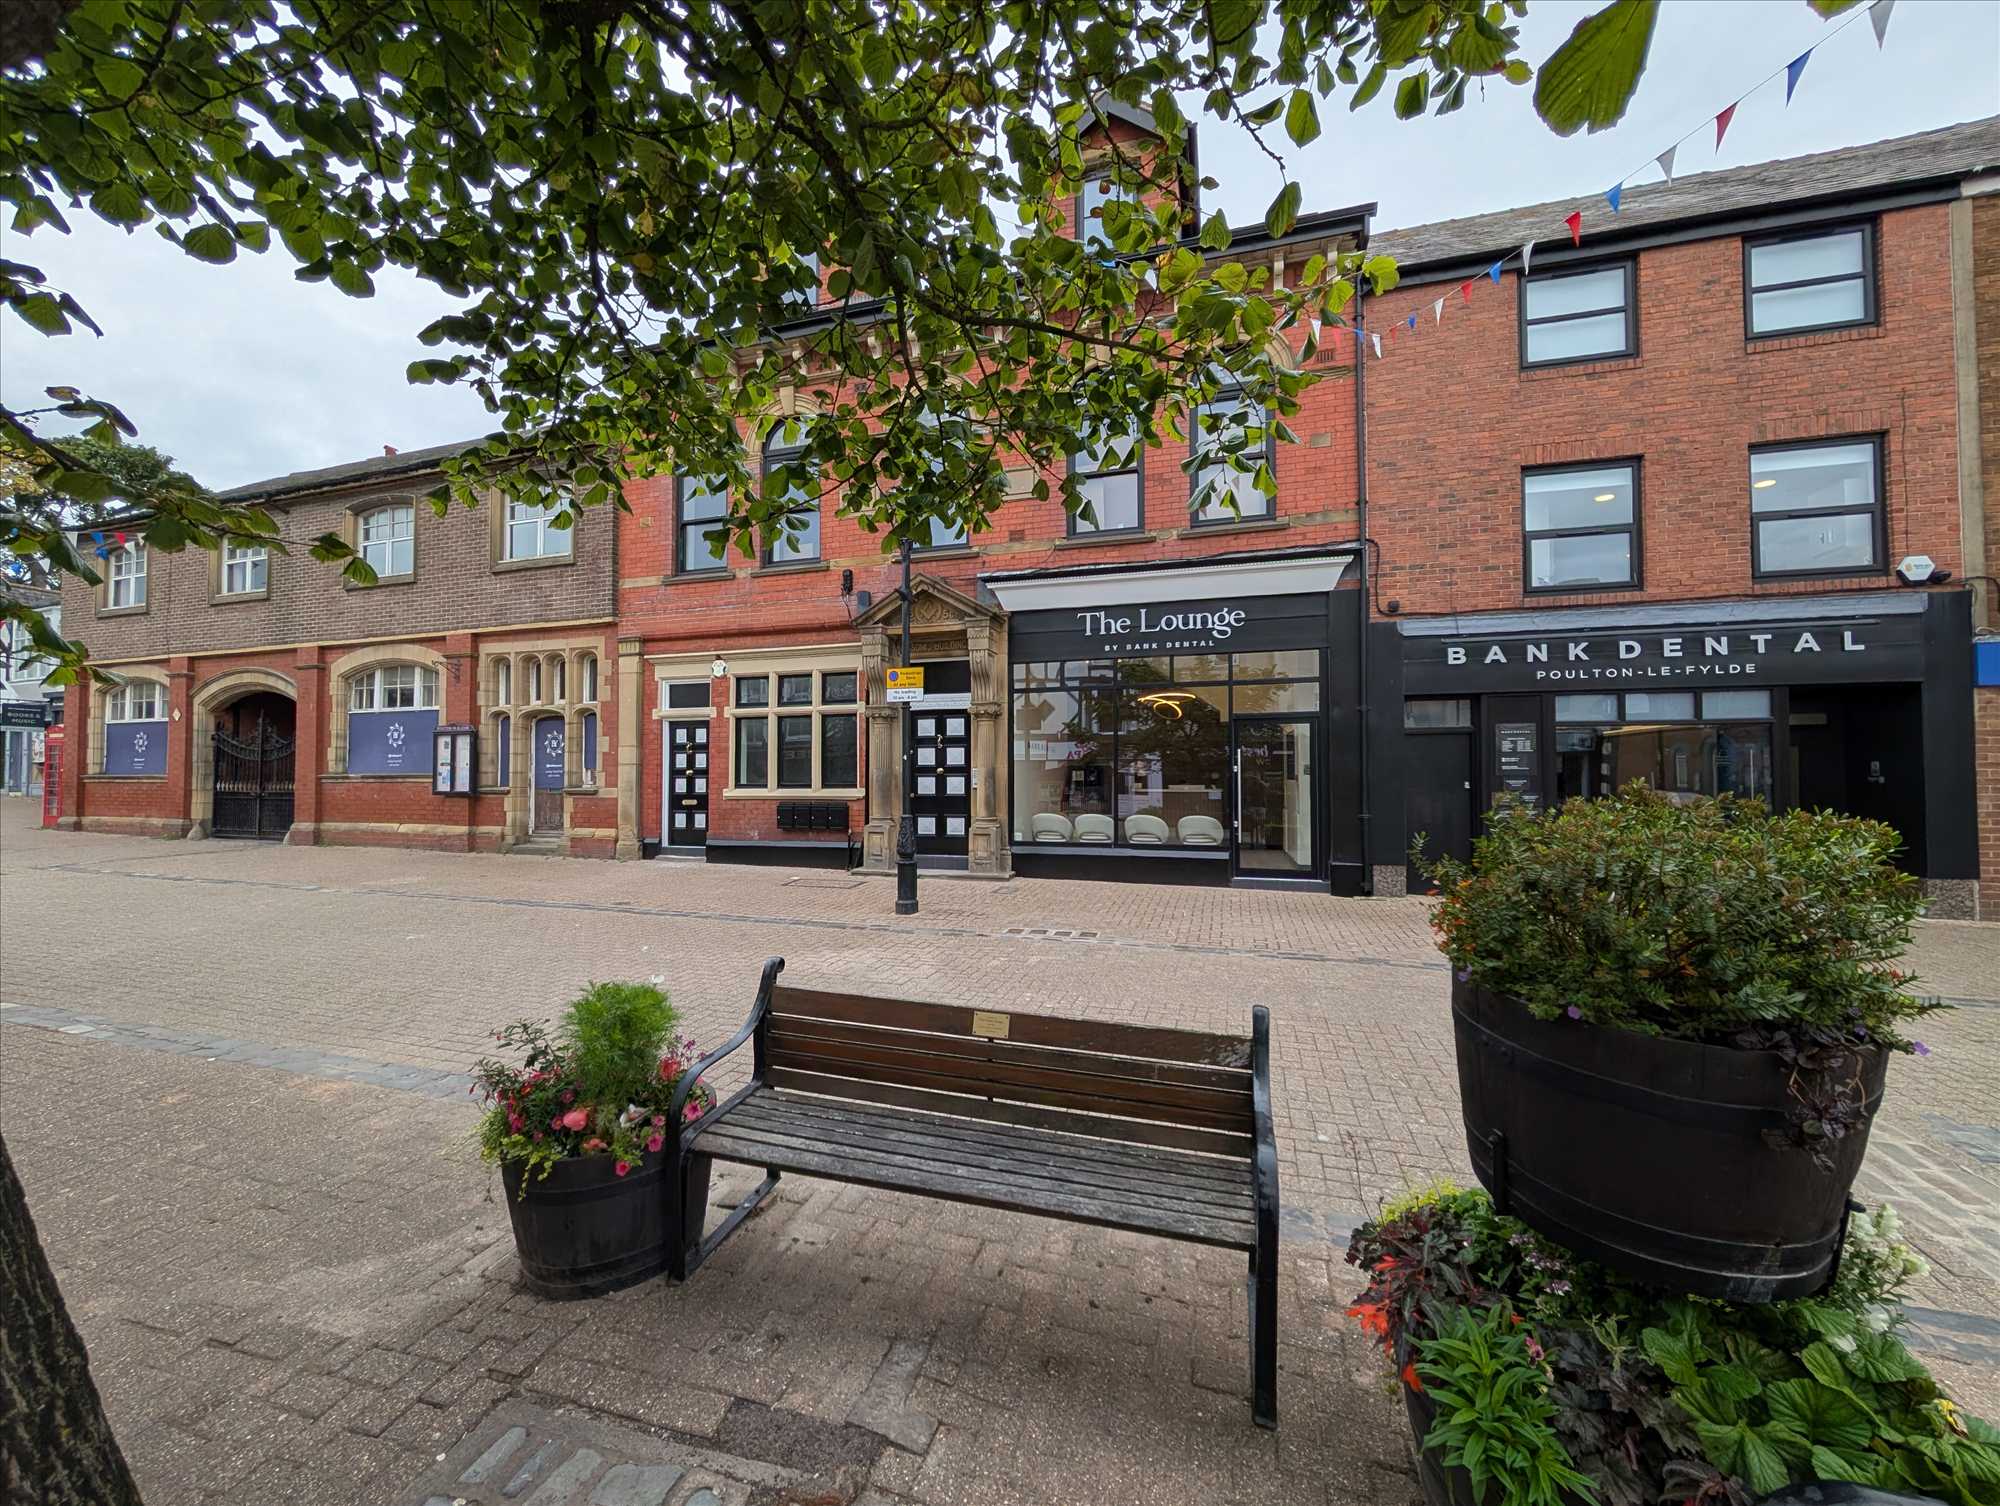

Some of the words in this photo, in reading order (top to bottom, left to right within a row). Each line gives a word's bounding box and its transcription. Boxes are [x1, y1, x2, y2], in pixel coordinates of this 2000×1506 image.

[1076, 610, 1132, 636] The
[1139, 607, 1246, 639] Lounge
[1104, 644, 1119, 652] BY
[1125, 642, 1158, 651] BANK
[1165, 639, 1215, 649] DENTAL
[1447, 642, 1590, 665] BANK
[1619, 630, 1866, 660] DENTAL
[1536, 663, 1756, 680] POULTON-LE-FYLDE
